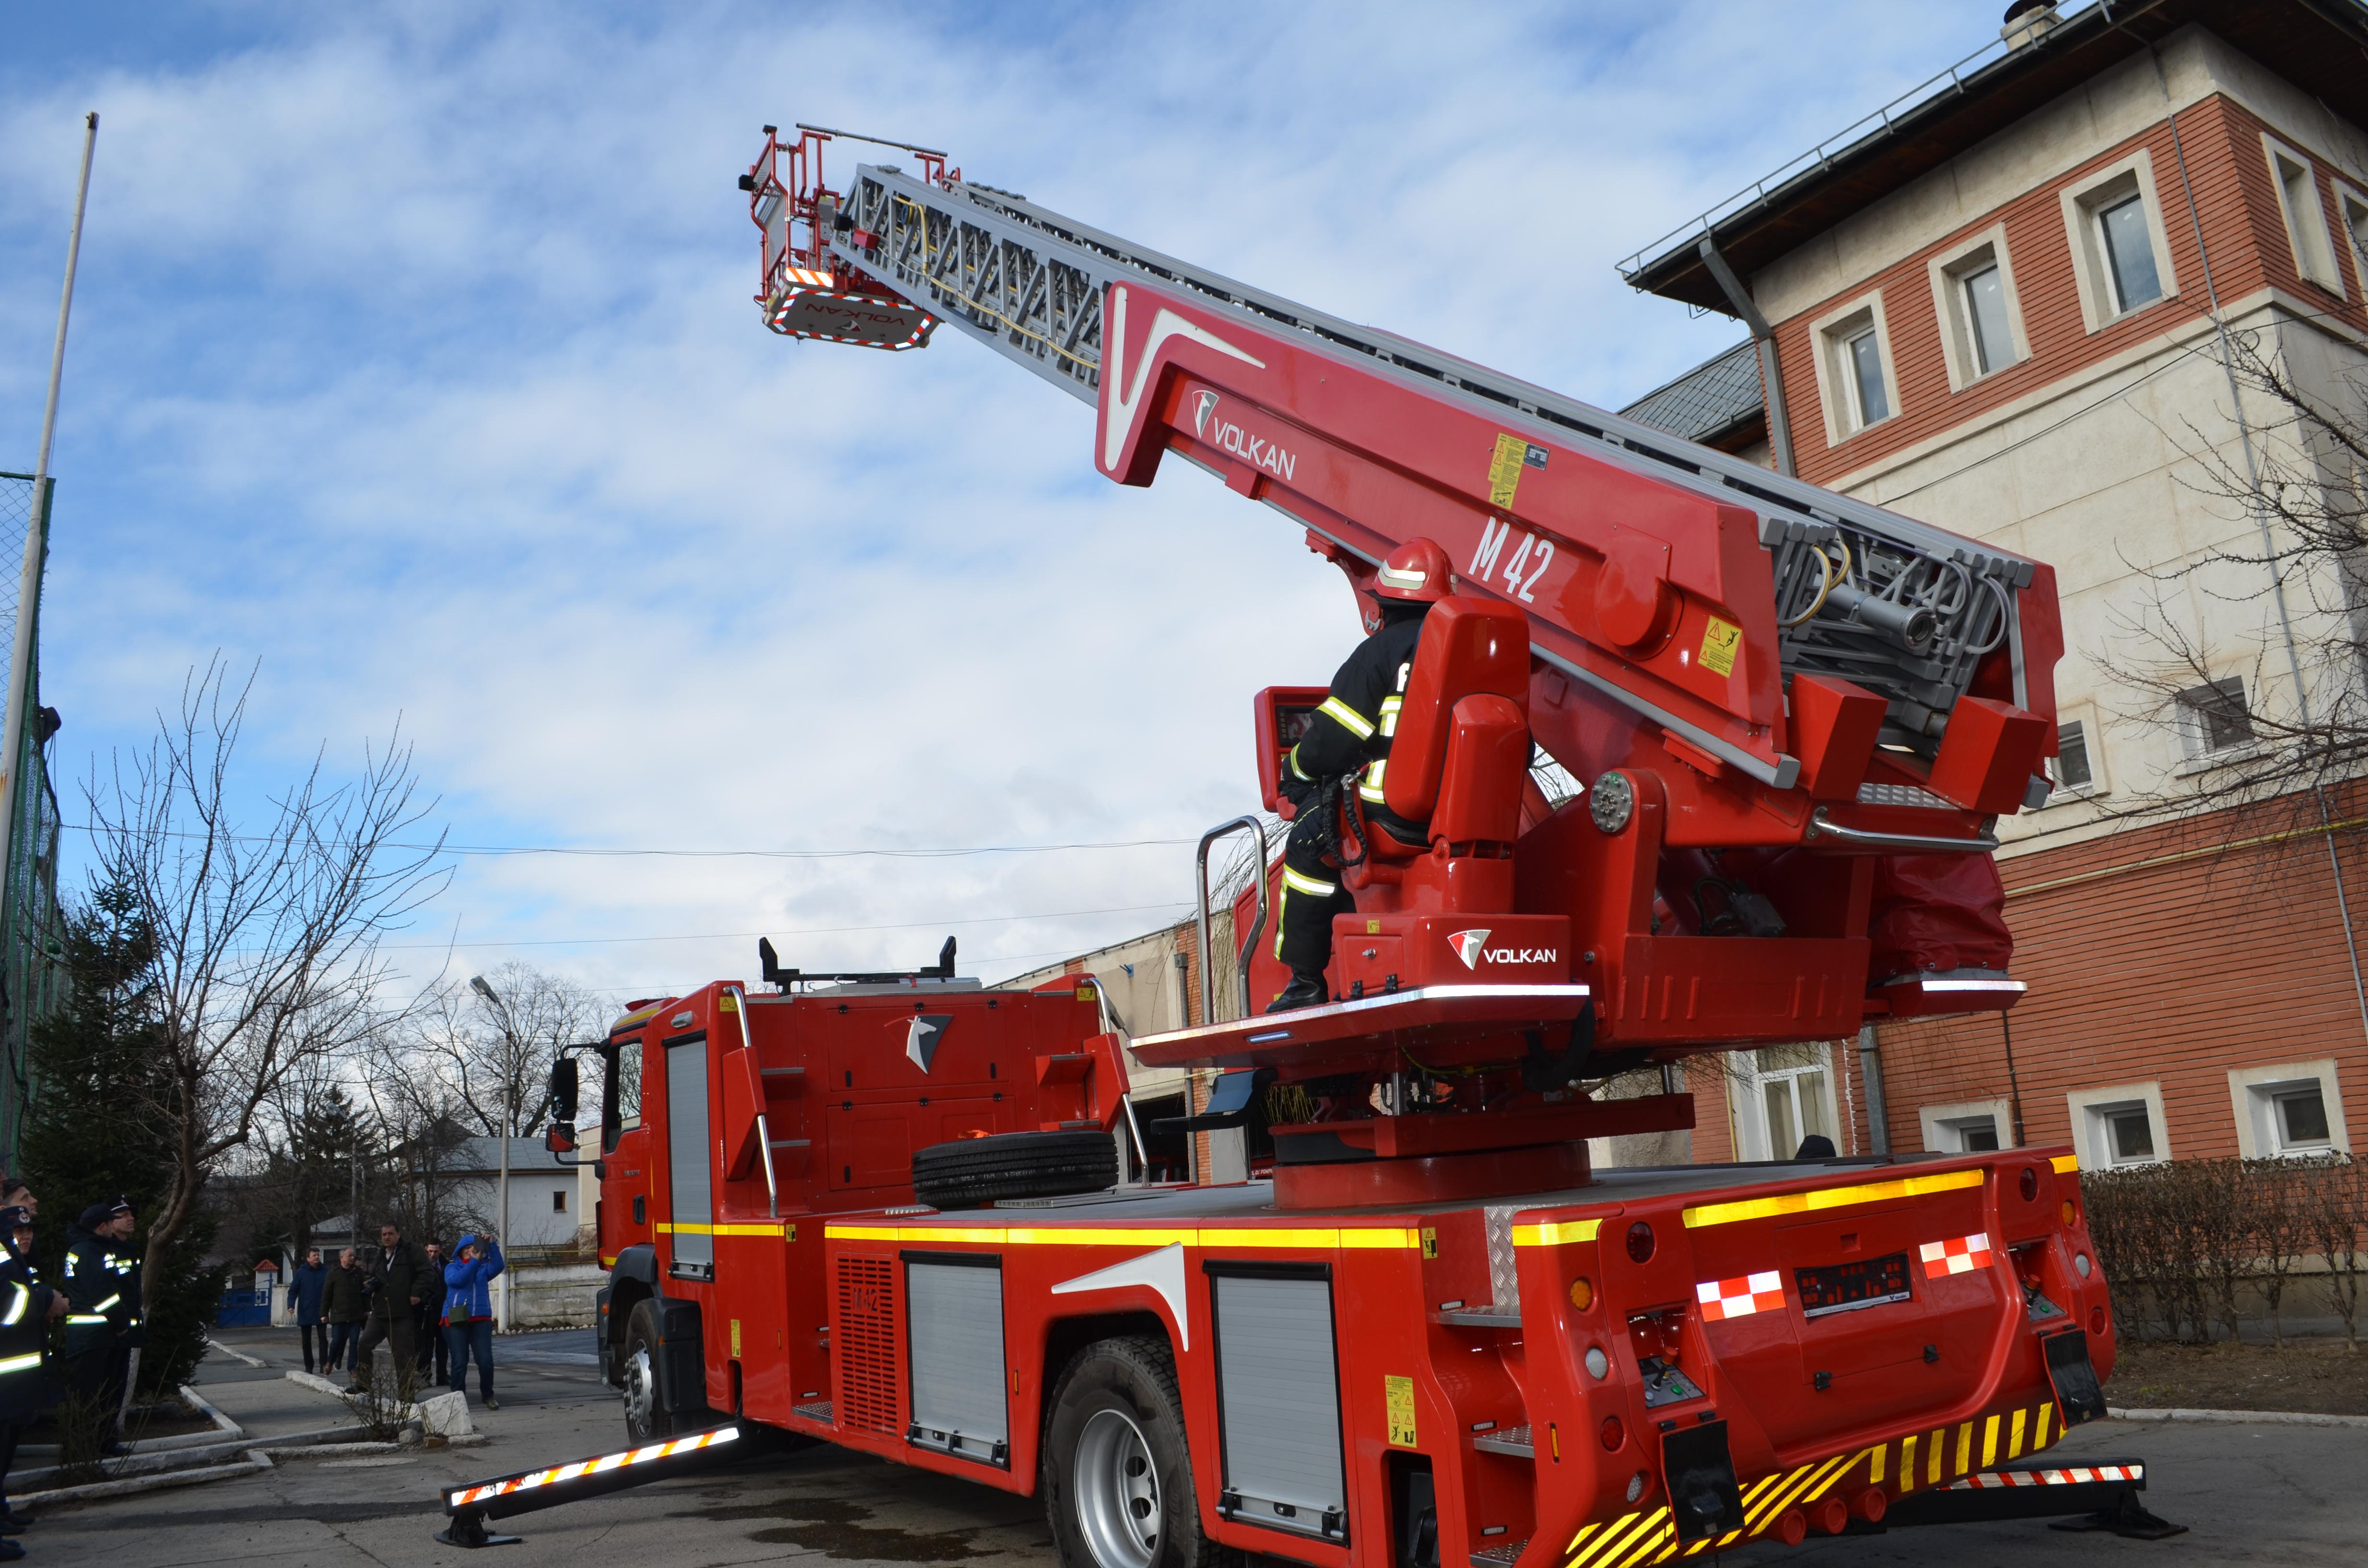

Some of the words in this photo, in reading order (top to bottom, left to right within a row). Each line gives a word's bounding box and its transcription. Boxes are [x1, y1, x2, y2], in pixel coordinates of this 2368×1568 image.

[805, 303, 905, 326] VOLKAN
[1215, 417, 1296, 480] VOLKAN
[1468, 515, 1510, 582] M
[1503, 532, 1554, 603] 42
[1483, 949, 1556, 963] VOLKAN
[853, 1287, 862, 1311] M
[864, 1288, 877, 1312] 42
